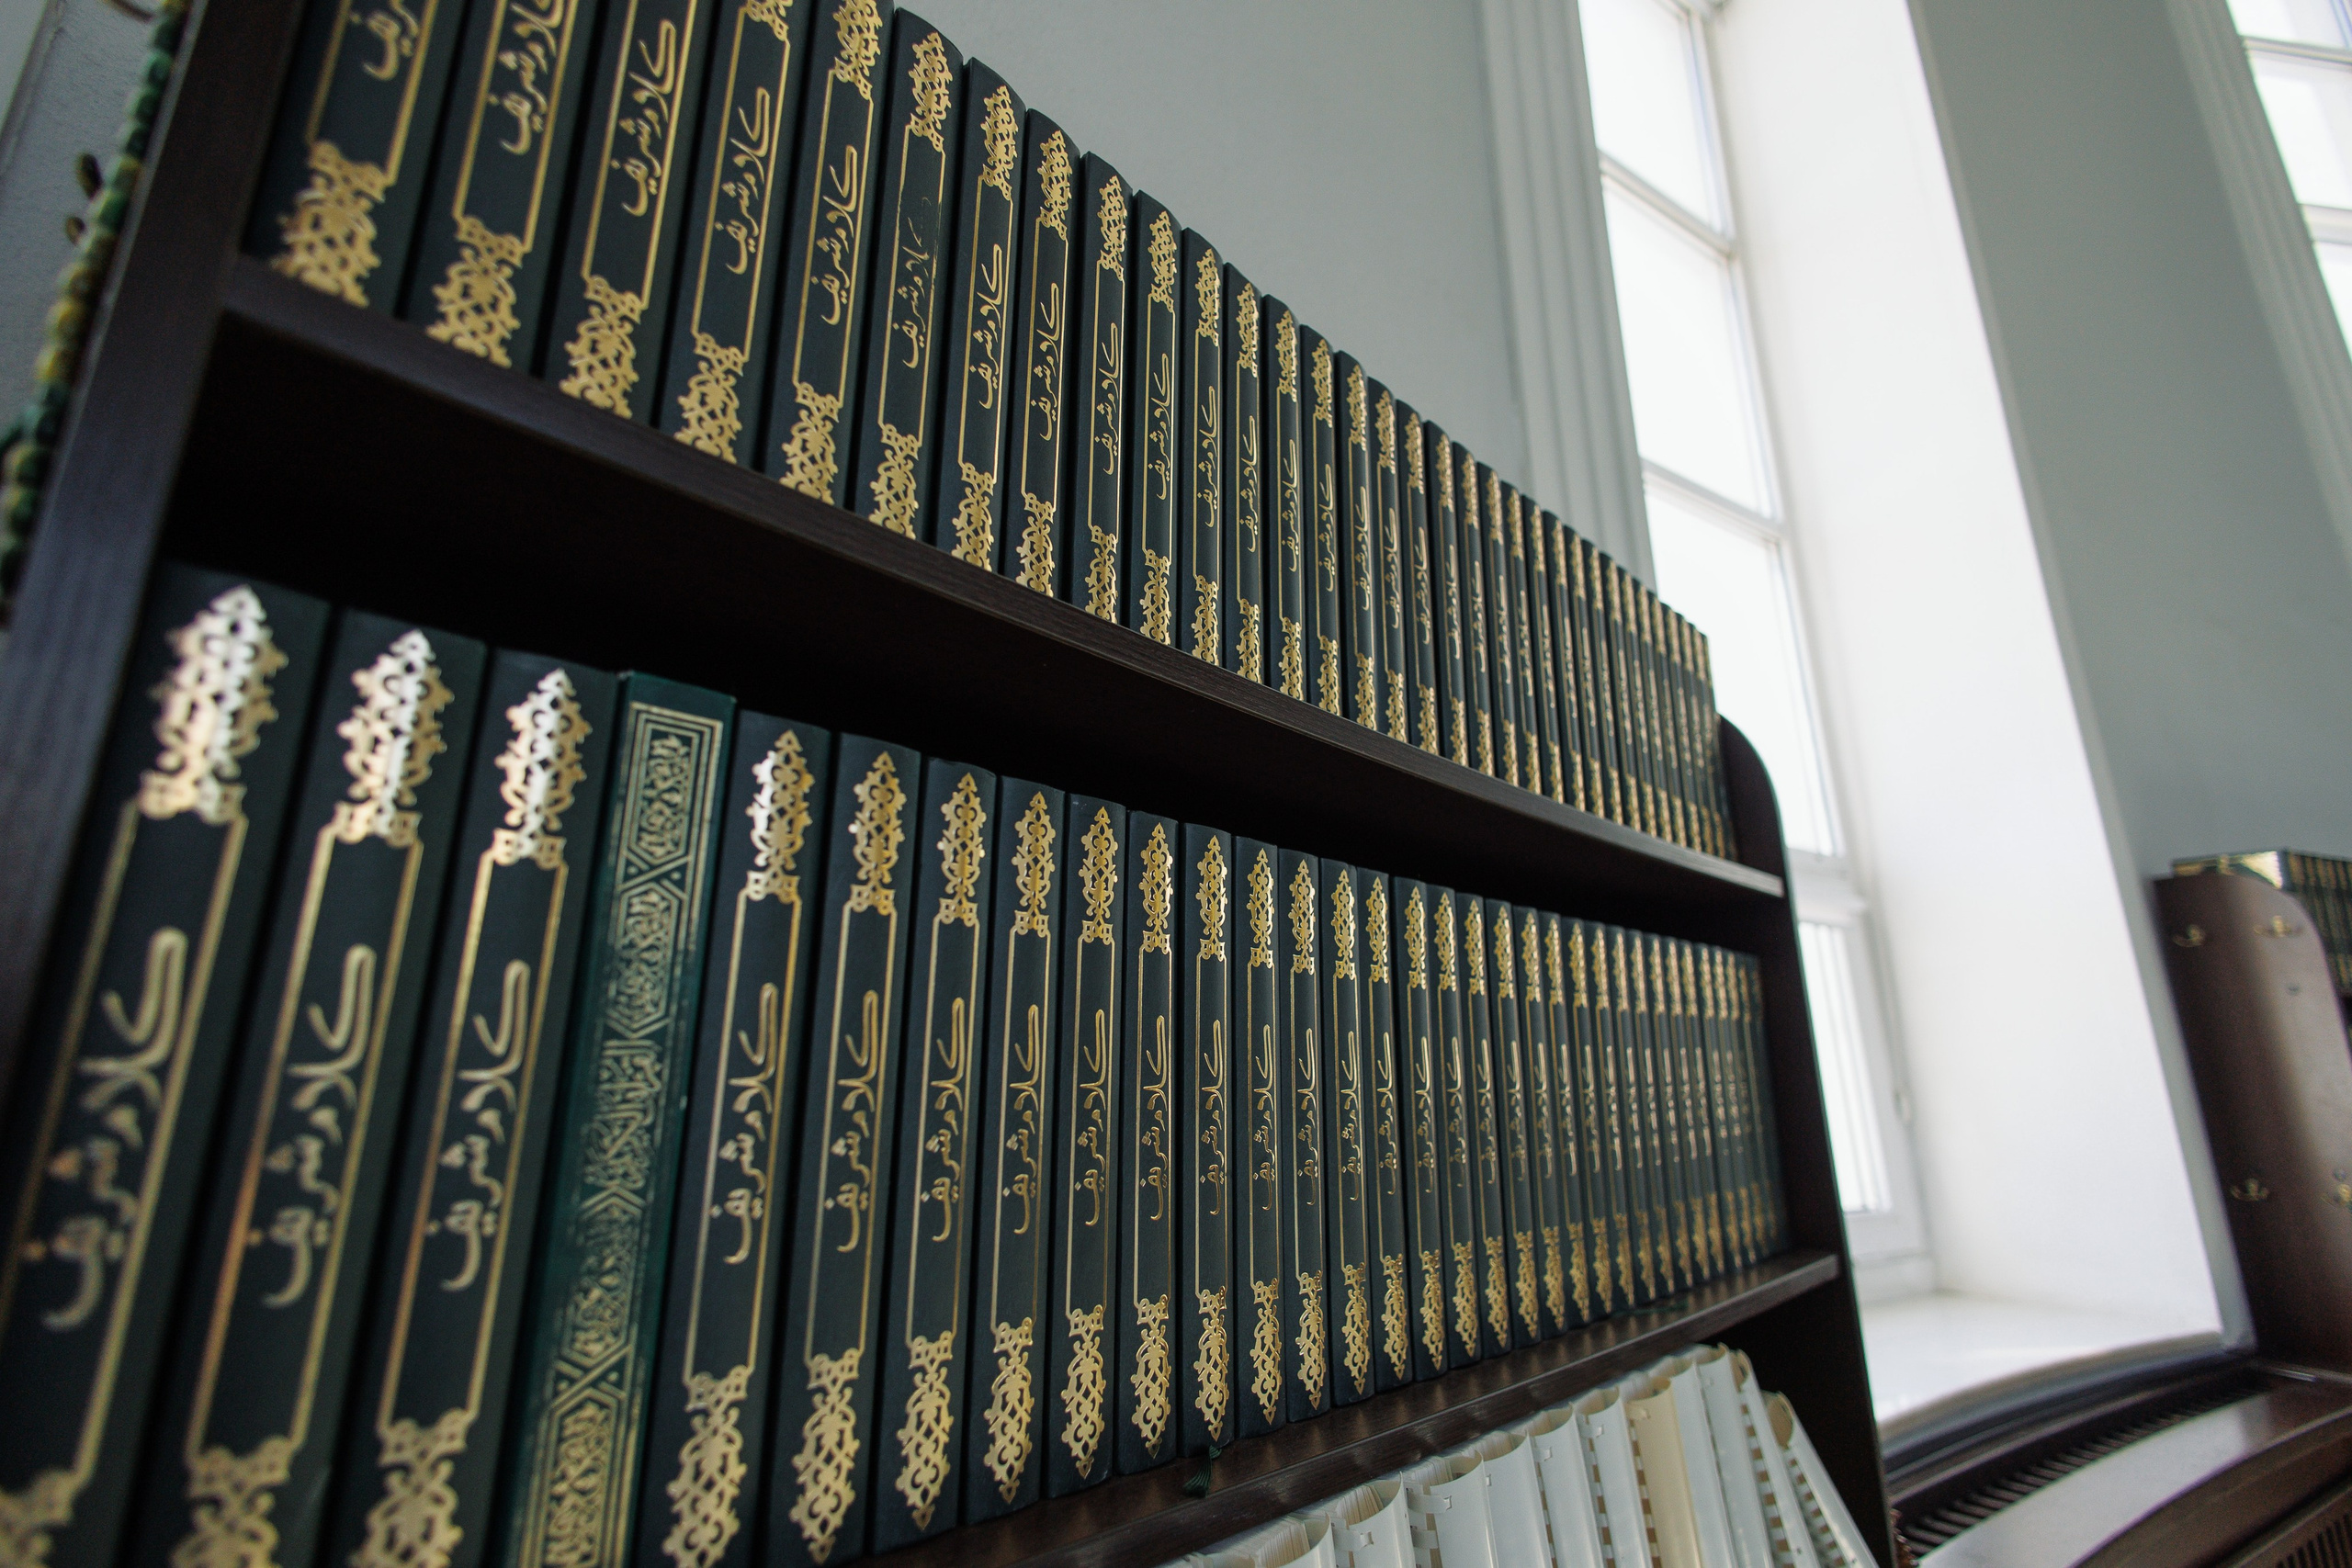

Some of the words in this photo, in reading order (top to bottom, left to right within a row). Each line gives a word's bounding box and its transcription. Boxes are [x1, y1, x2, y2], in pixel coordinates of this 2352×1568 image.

[349, 0, 419, 81] ريف
[510, 0, 564, 74] لام
[629, 19, 675, 139] كلام
[611, 117, 662, 216] شريف
[730, 86, 770, 200] كلام
[715, 182, 759, 276] شريف
[823, 145, 857, 254] كلام
[811, 237, 850, 325] شريف
[977, 243, 1002, 343] كلام
[969, 329, 999, 410] شريف
[1036, 282, 1059, 377] كلام
[1099, 322, 1118, 413] كلام
[1031, 365, 1057, 441] شريف
[1094, 402, 1118, 475] شريف
[1150, 353, 1170, 439] كلام
[1199, 385, 1216, 469] كلام
[1148, 431, 1170, 500] شريف
[1197, 460, 1217, 527] شريف
[1241, 415, 1257, 496] كلام
[1282, 439, 1297, 517] كلام
[1318, 463, 1333, 539] كلام
[1239, 488, 1258, 552] شريف
[1281, 510, 1299, 572] شريف
[1318, 532, 1335, 592] شريف
[1354, 486, 1369, 558] كلام
[1354, 552, 1370, 611] شريف
[287, 944, 376, 1147] كلام
[458, 960, 530, 1145] كلام
[729, 982, 778, 1141] كلام
[837, 989, 878, 1138] كلام
[931, 997, 965, 1135] كلام
[1009, 1005, 1039, 1134] كلام
[1080, 1009, 1106, 1133] كلام
[1143, 1015, 1168, 1131] كلام
[1202, 1020, 1224, 1130] كلام
[1253, 1024, 1273, 1129] كلام
[1297, 1028, 1316, 1129] كلام
[1340, 1031, 1359, 1128] كلام
[1377, 1032, 1394, 1124] كلام
[1415, 1036, 1431, 1123] كلام
[710, 1133, 766, 1265] شريف
[825, 1131, 871, 1253] شريف
[922, 1129, 961, 1243] شريف
[1002, 1128, 1037, 1235] شريف
[1075, 1126, 1105, 1226] شريف
[1139, 1126, 1168, 1221] شريف
[1200, 1125, 1225, 1215] شريف
[1253, 1125, 1275, 1211] شريف
[1297, 1124, 1318, 1205] شريف
[1341, 1122, 1361, 1201] شريف
[1379, 1121, 1397, 1195] شريف
[1417, 1121, 1434, 1193] شريف
[246, 1134, 341, 1309] شريف
[424, 1134, 505, 1292] شريف
